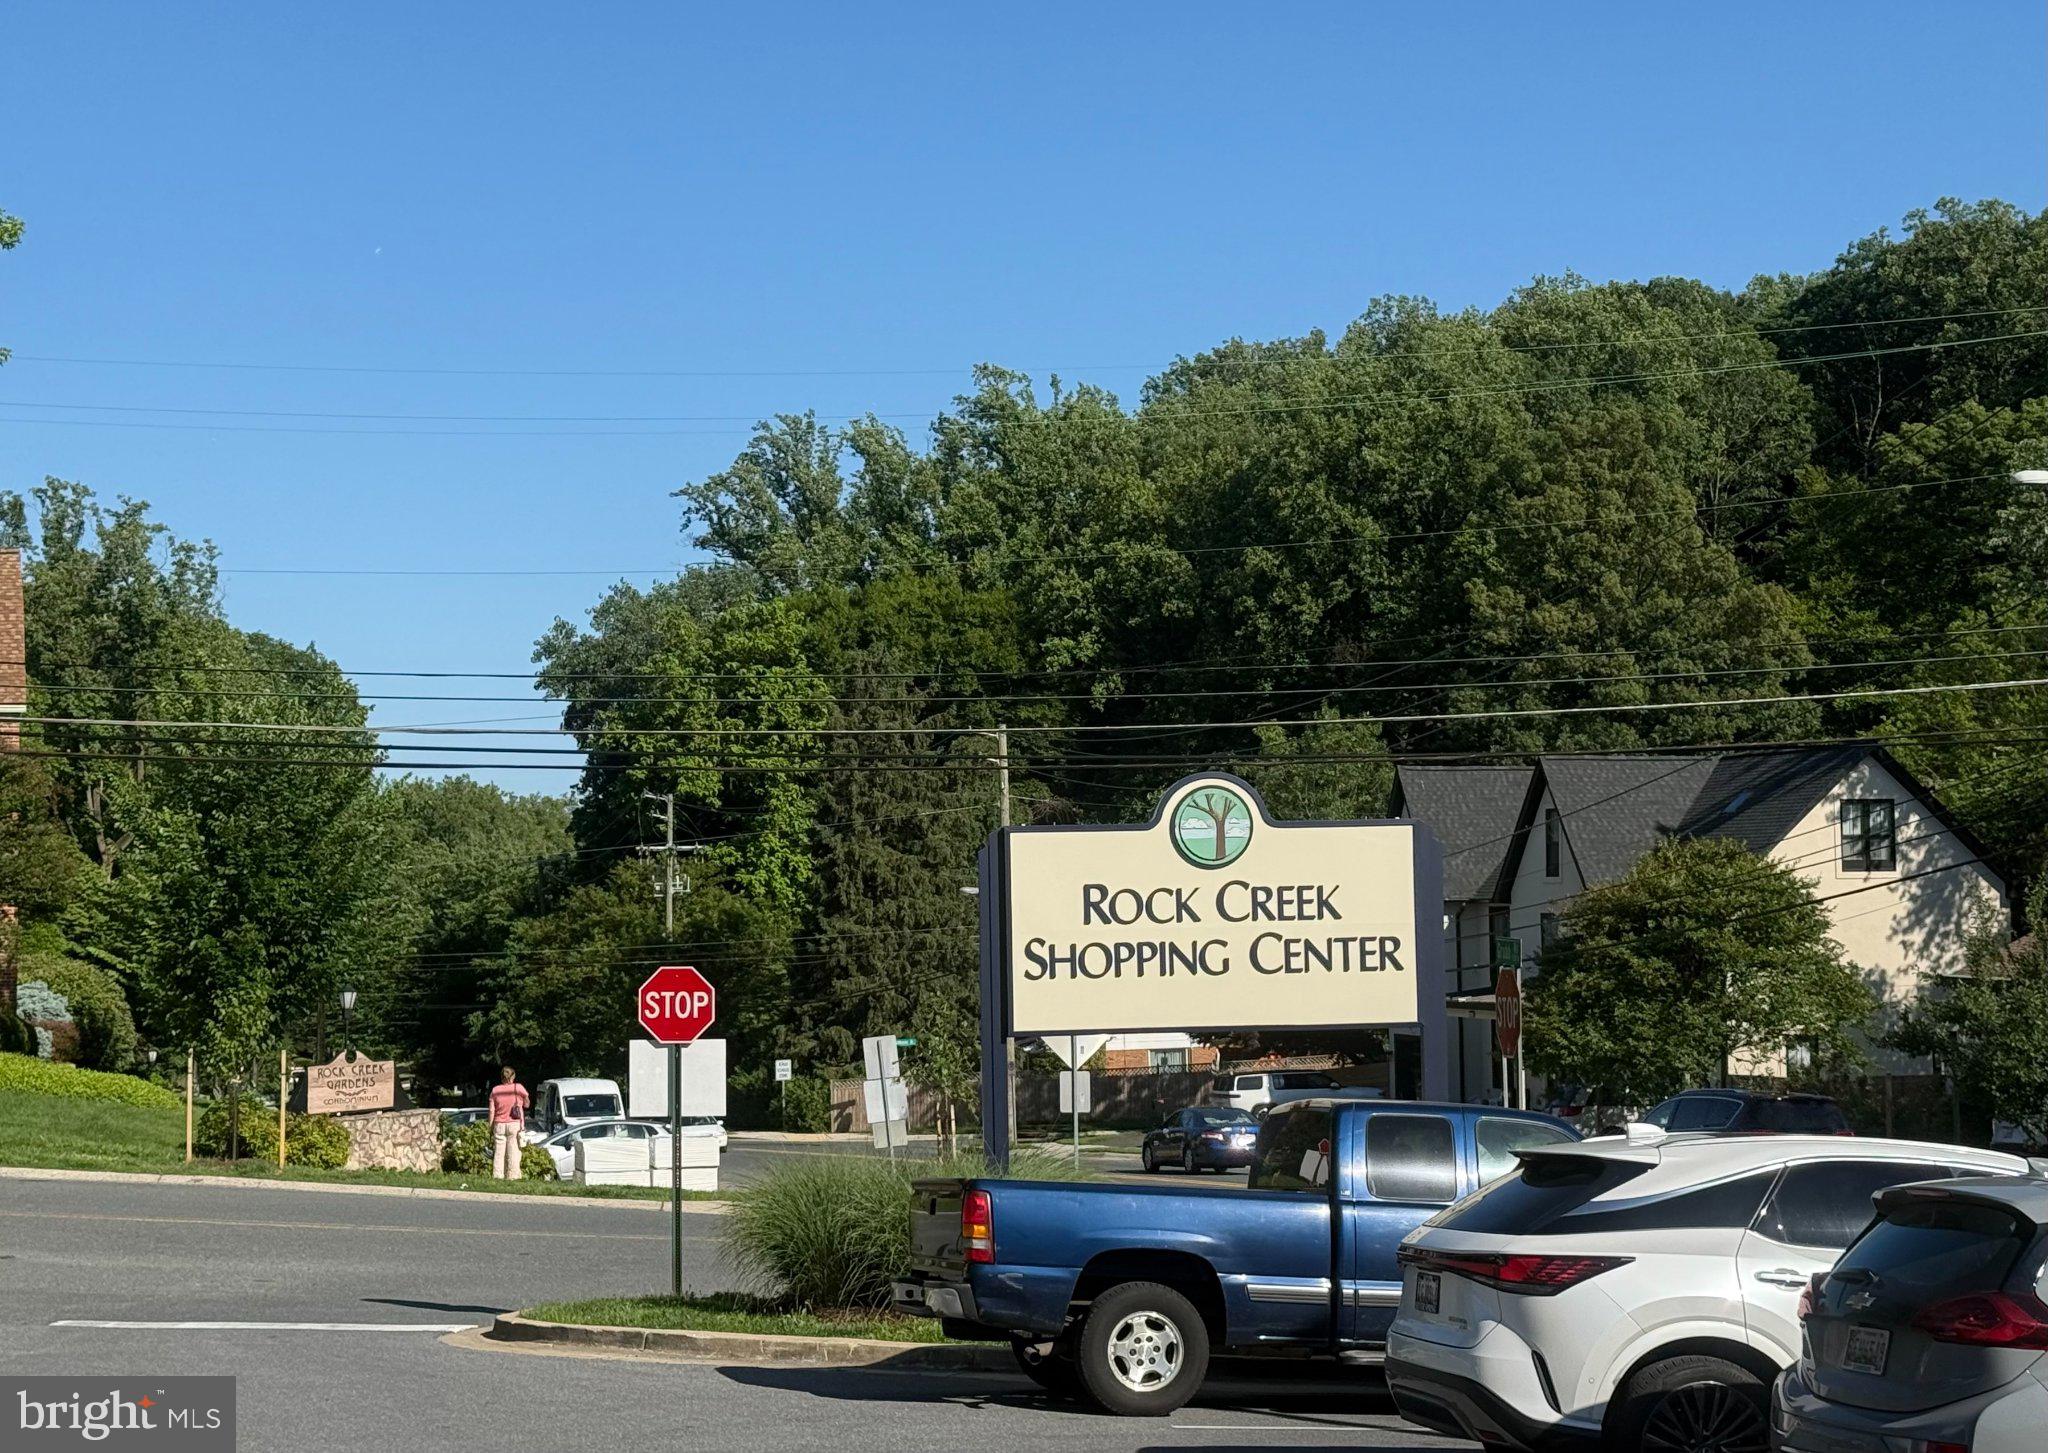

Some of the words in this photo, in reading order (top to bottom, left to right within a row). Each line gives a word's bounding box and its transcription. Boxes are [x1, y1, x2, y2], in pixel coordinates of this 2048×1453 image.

[1082, 883, 1202, 926] ROCK
[1215, 879, 1343, 923] CREEK
[1023, 937, 1231, 981] SHOPPING
[1249, 931, 1405, 976] CENTER
[644, 990, 709, 1019] STOP
[1497, 996, 1519, 1029] STOP
[317, 1065, 346, 1079] ROCK
[351, 1063, 386, 1076] CREEK
[326, 1076, 376, 1090] GARDENS
[323, 1094, 379, 1106] CONDOMINIUM
